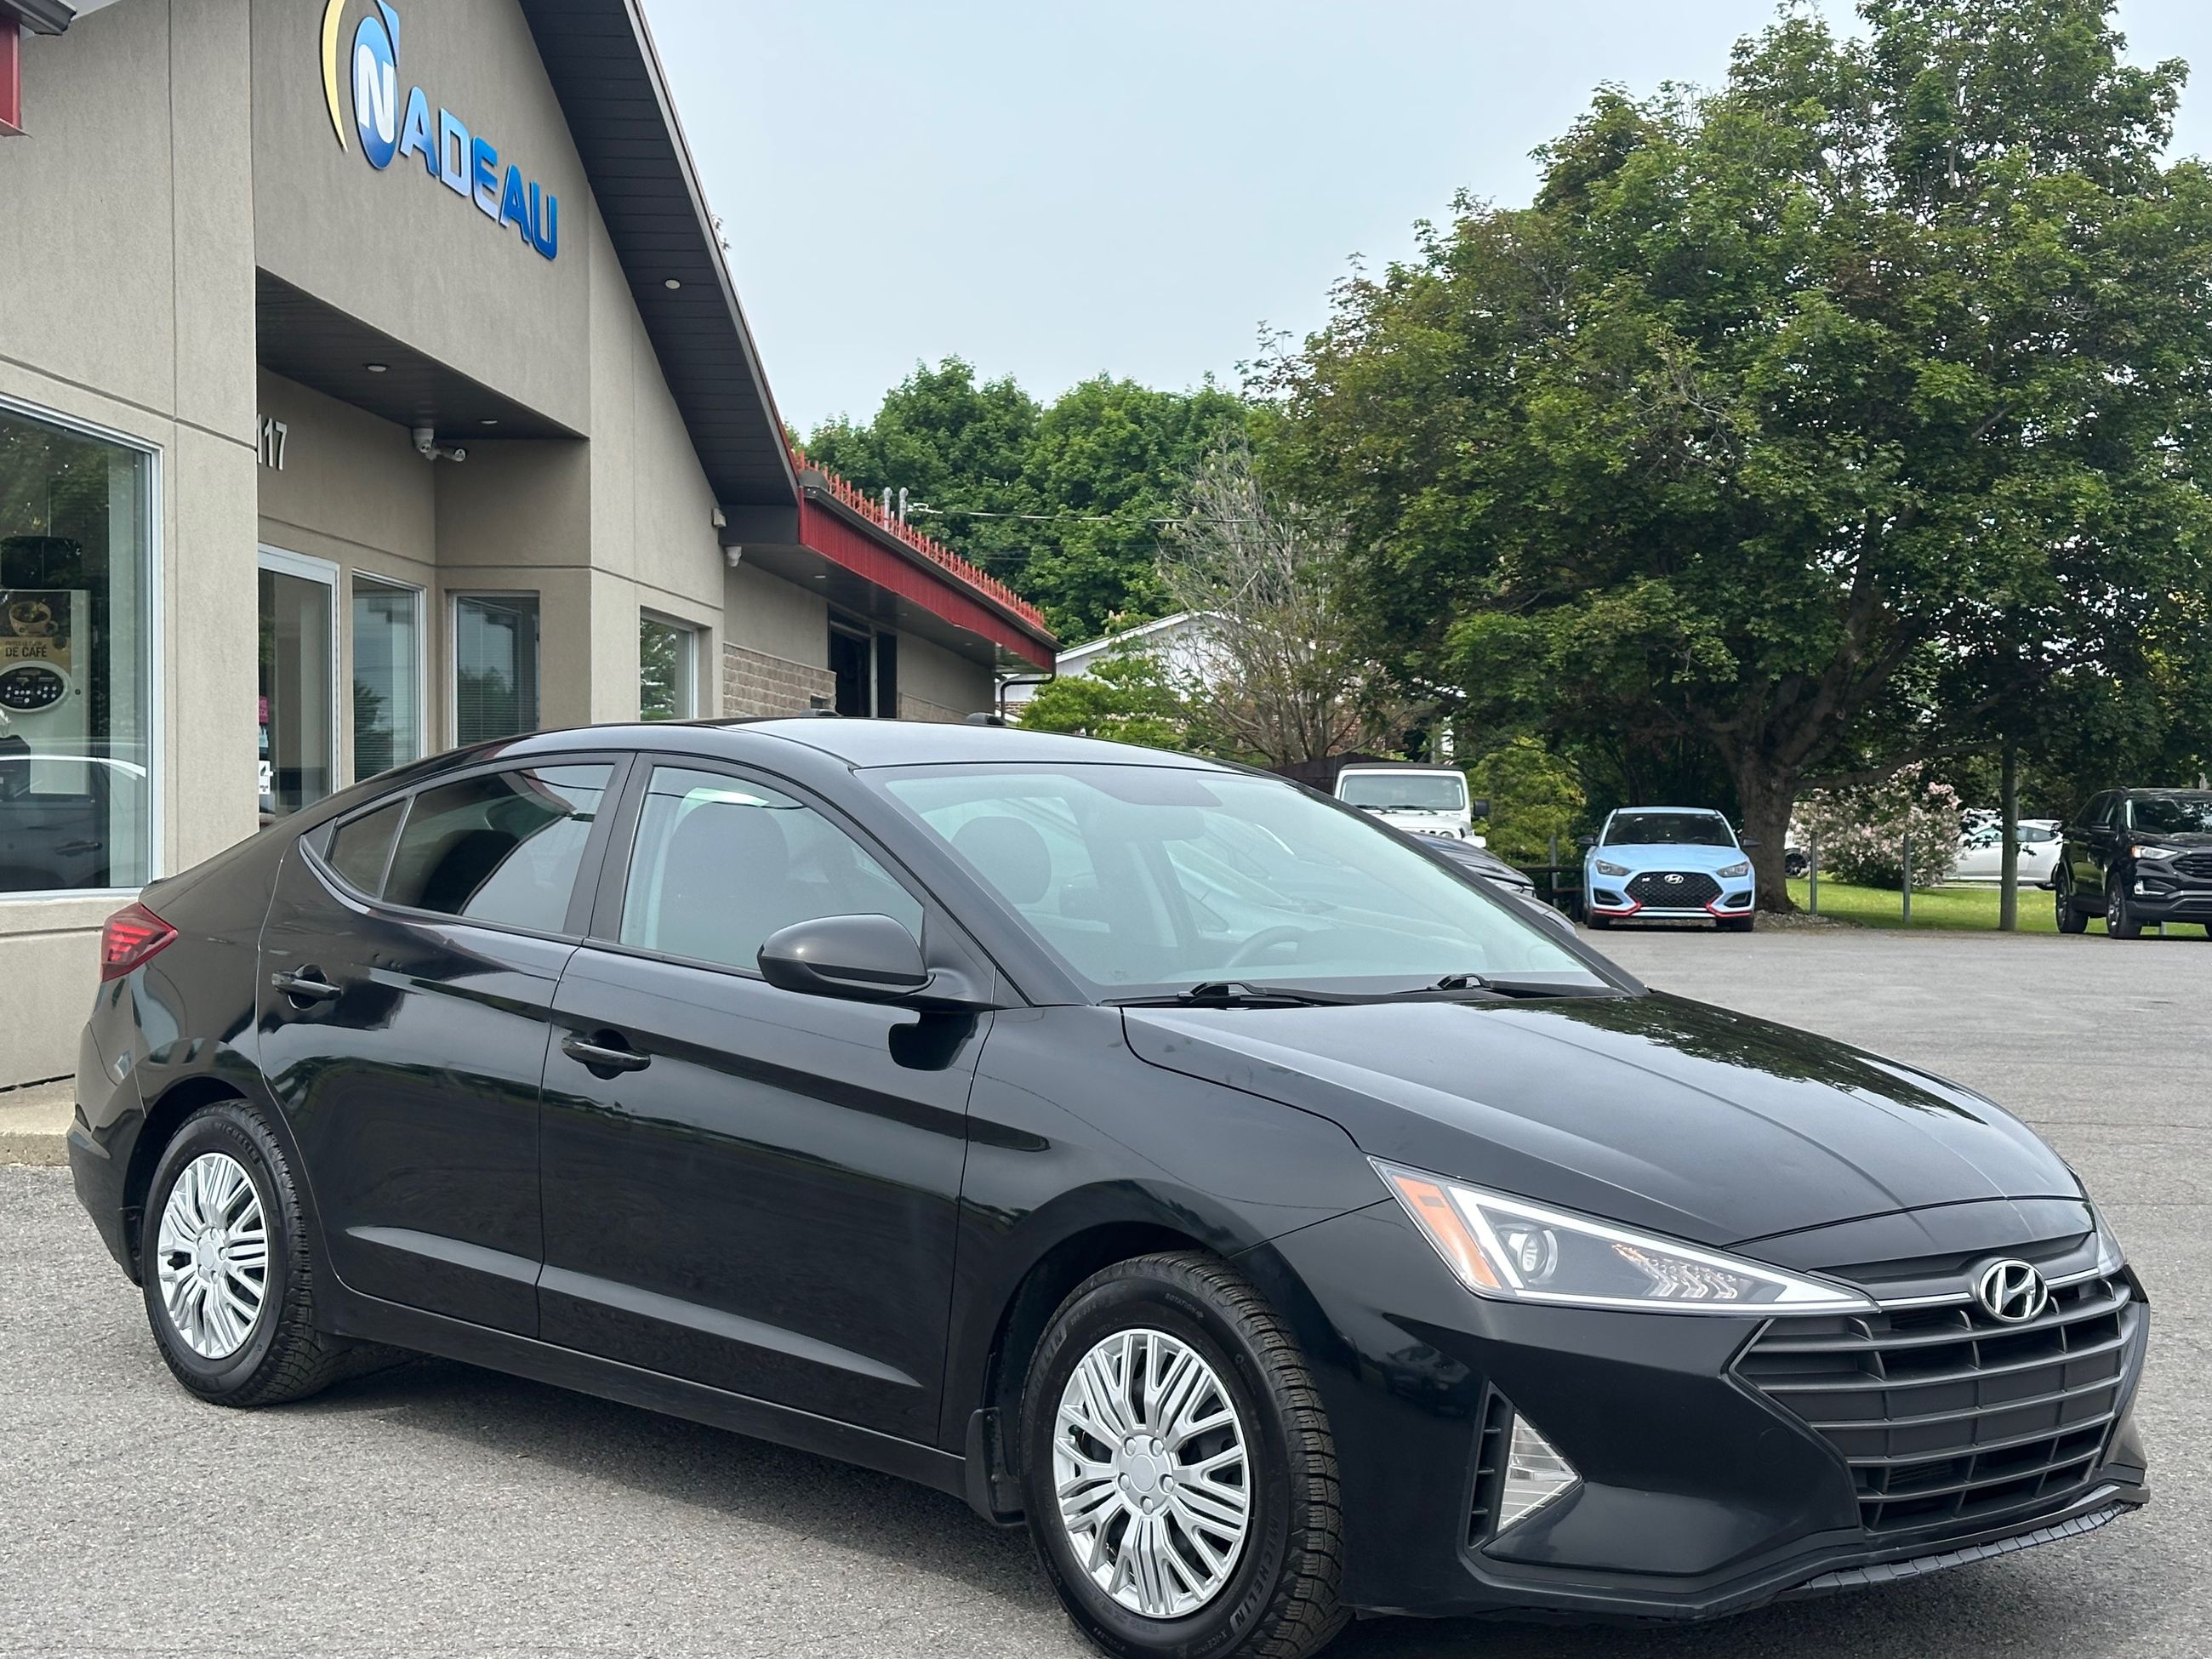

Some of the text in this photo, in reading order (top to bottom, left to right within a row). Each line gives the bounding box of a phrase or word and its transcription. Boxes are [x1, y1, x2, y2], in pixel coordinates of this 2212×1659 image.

[356, 43, 558, 260] NADEAU
[5, 644, 48, 658] DE CAFÉ
[1164, 1292, 1198, 1314] ROTATION
[1234, 1517, 1280, 1628] MICHELIN
